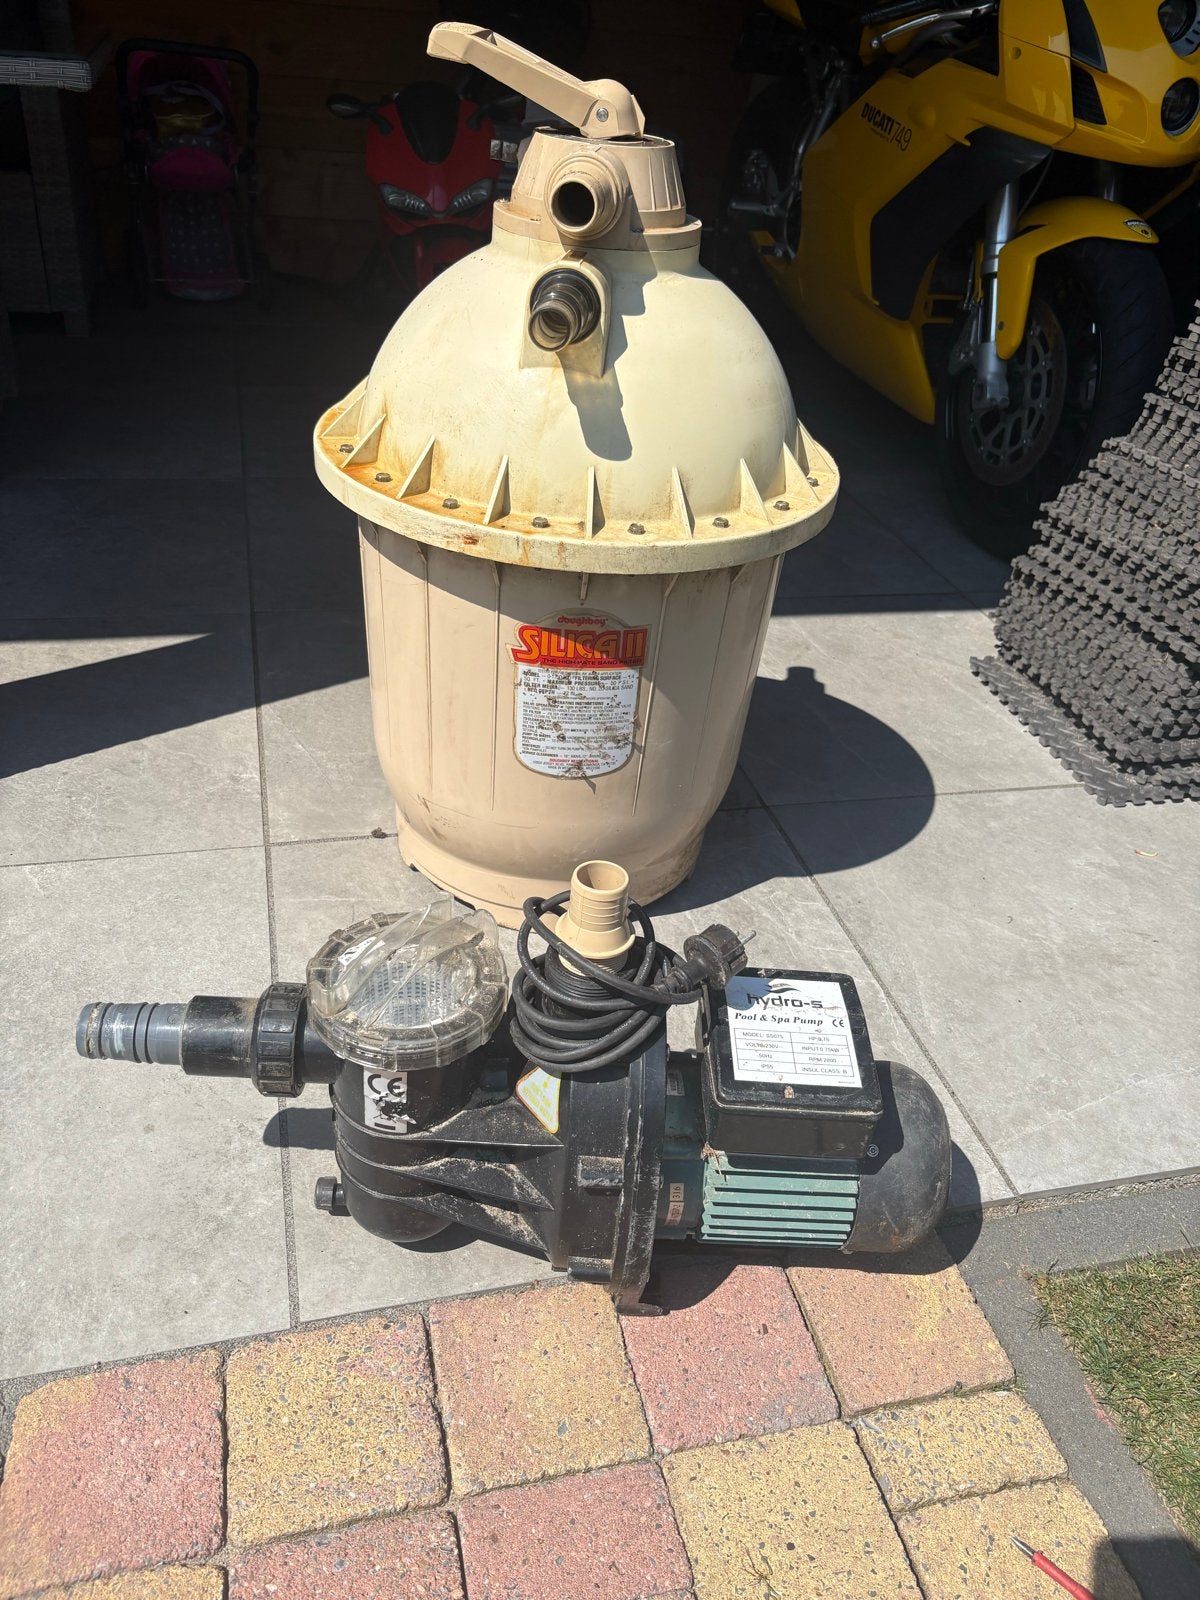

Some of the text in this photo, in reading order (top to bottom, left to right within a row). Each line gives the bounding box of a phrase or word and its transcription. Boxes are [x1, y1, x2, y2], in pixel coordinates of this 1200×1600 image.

[861, 102, 894, 136] DUCATI
[890, 121, 912, 152] 749
[558, 616, 606, 627] doughboy
[512, 628, 618, 661] SILICA
[747, 993, 824, 1010] hydro-s
[735, 1012, 756, 1020] Pool
[771, 1015, 790, 1024] Spa
[794, 1016, 824, 1026] Pump
[672, 1186, 681, 1198] 316
